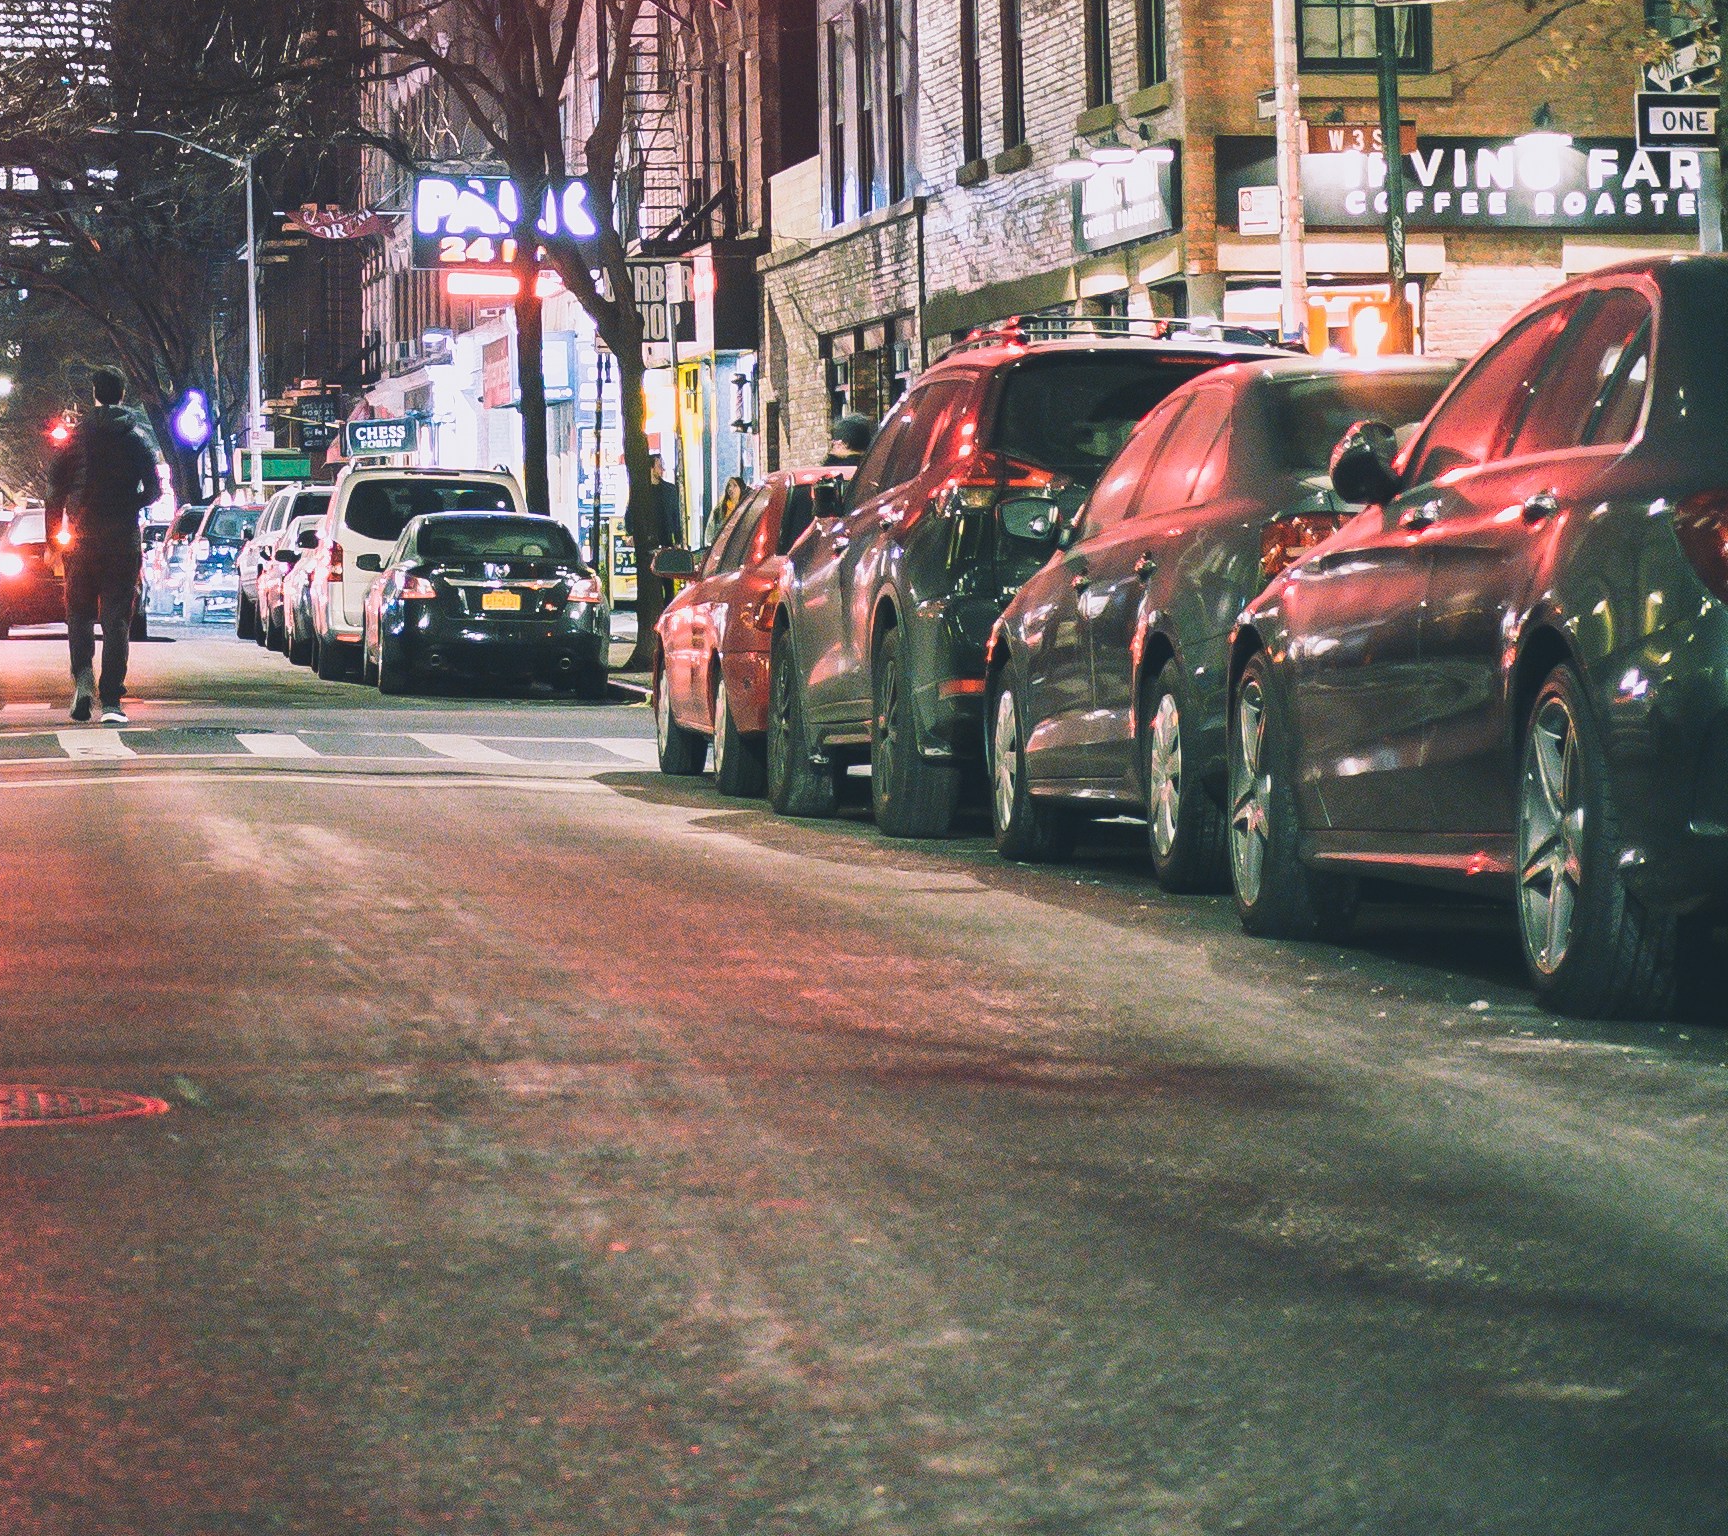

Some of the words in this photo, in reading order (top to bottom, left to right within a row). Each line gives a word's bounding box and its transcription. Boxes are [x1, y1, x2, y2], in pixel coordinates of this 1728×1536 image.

[1662, 110, 1709, 132] ONE
[1328, 129, 1345, 151] W
[1352, 129, 1365, 151] 3
[1372, 129, 1383, 151] S
[1587, 148, 1701, 190] FAR
[1534, 191, 1698, 216] ROASTE
[355, 425, 406, 440] CHESS
[360, 438, 402, 449] FORUM
